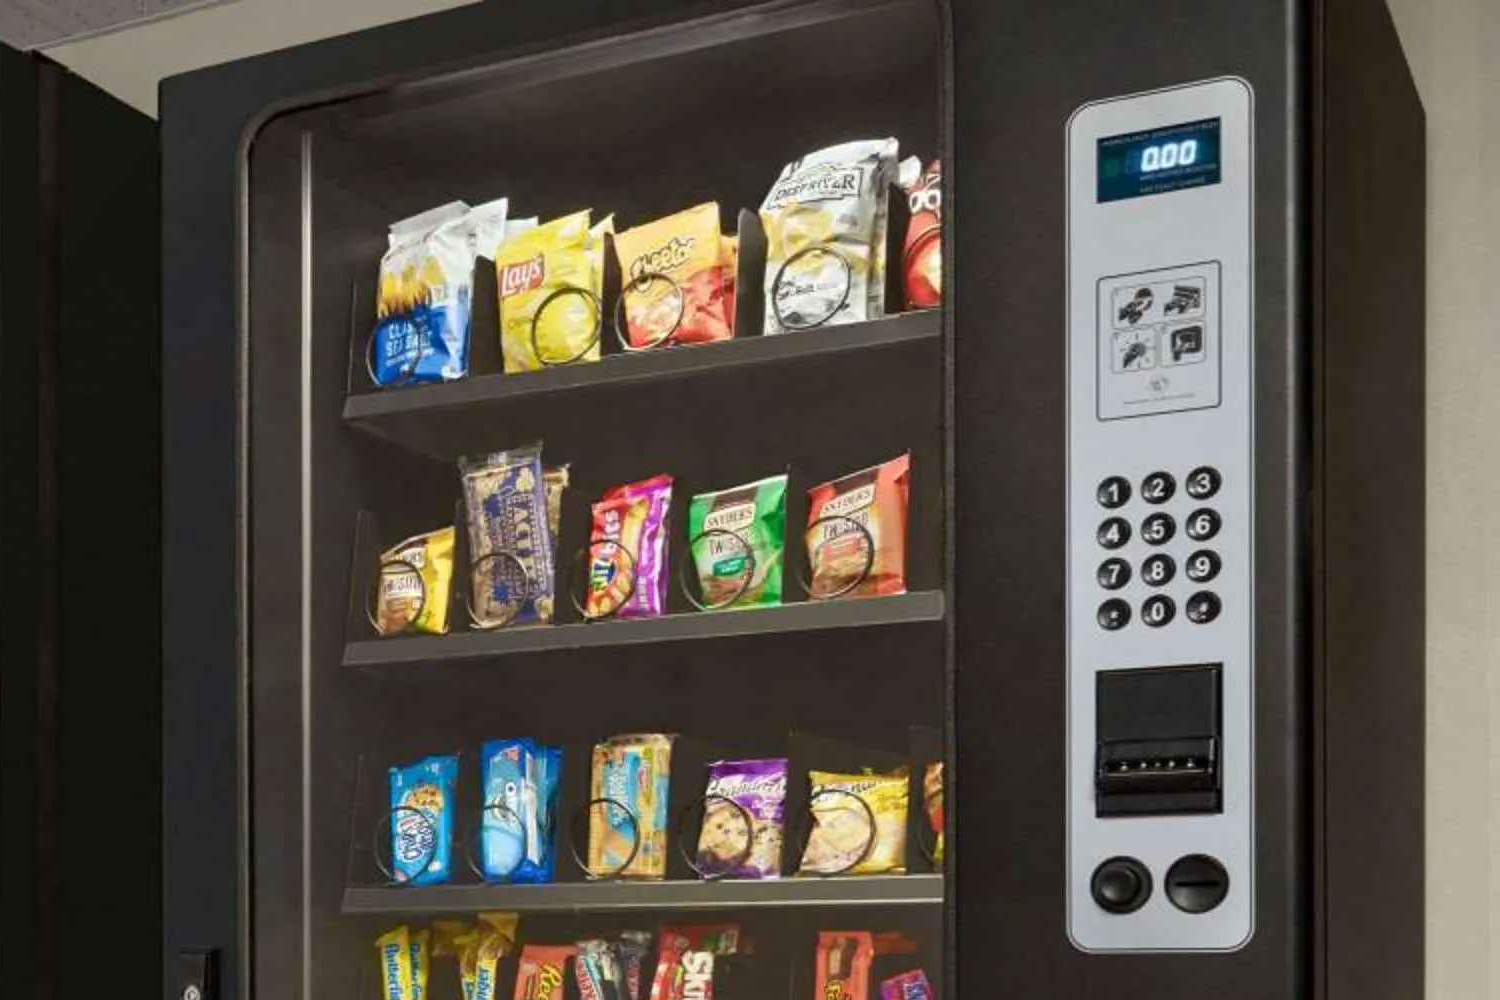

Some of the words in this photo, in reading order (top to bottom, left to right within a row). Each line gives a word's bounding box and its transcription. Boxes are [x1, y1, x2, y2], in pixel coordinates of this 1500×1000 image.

[1107, 482, 1119, 502] 1
[1152, 478, 1165, 498] 2
[1196, 473, 1211, 493] 3
[1106, 523, 1120, 542] 4
[1151, 519, 1165, 539] 5
[1195, 515, 1211, 535] 6
[1108, 564, 1120, 584] 7
[1151, 561, 1165, 580] 8
[1195, 557, 1211, 577] 9
[1151, 602, 1165, 621] 0
